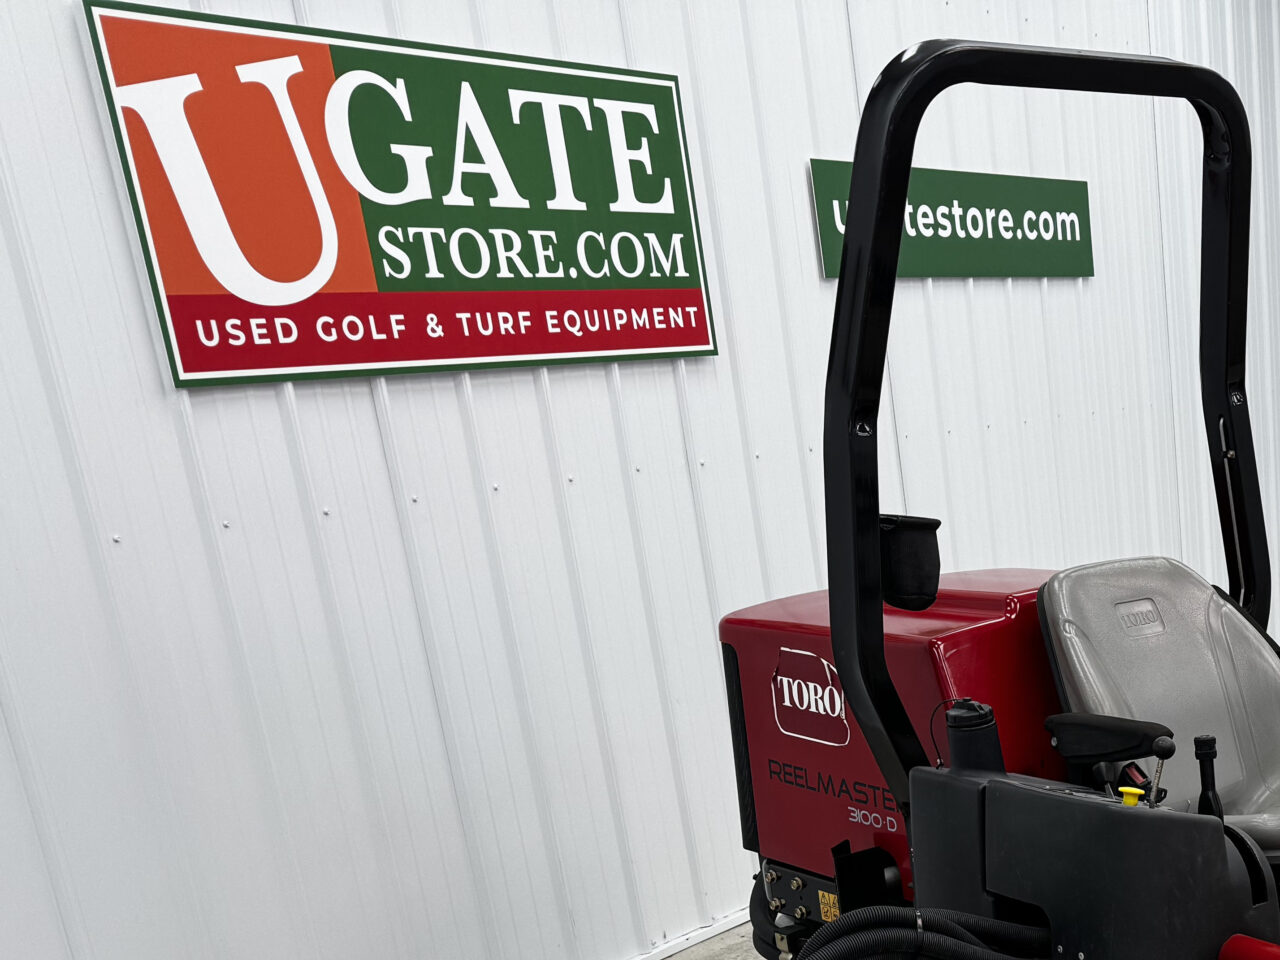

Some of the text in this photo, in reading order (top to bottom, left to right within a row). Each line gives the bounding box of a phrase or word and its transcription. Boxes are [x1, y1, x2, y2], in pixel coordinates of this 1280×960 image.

[832, 197, 1082, 242] utestore.com
[377, 225, 690, 280] STORE.COM
[195, 306, 699, 348] USED GOLF & TURF EQUIPMENT
[1119, 608, 1159, 629] TORO
[776, 675, 841, 718] TORO
[767, 758, 901, 815] REELMASTE
